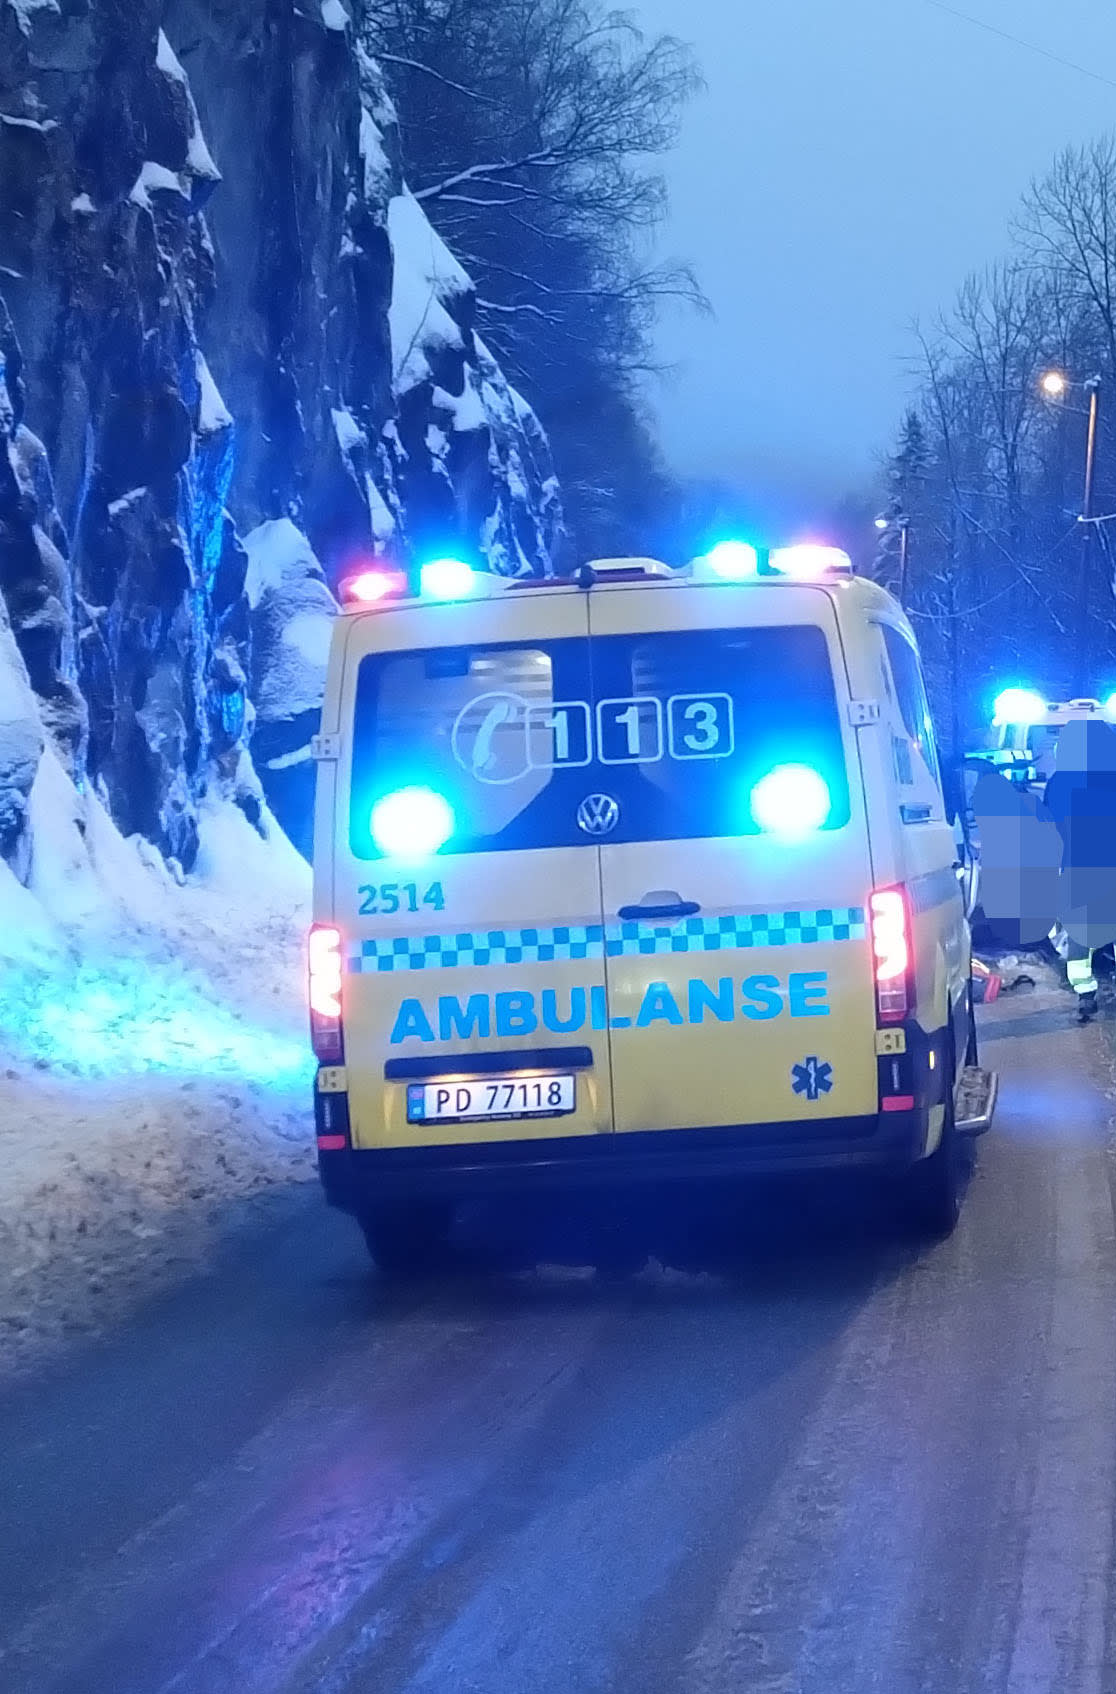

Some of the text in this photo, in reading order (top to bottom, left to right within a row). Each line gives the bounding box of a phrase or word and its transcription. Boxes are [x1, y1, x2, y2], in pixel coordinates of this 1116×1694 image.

[358, 882, 445, 915] 2514
[390, 971, 831, 1044] AMBULANSE
[437, 1082, 562, 1113] PD 77118
